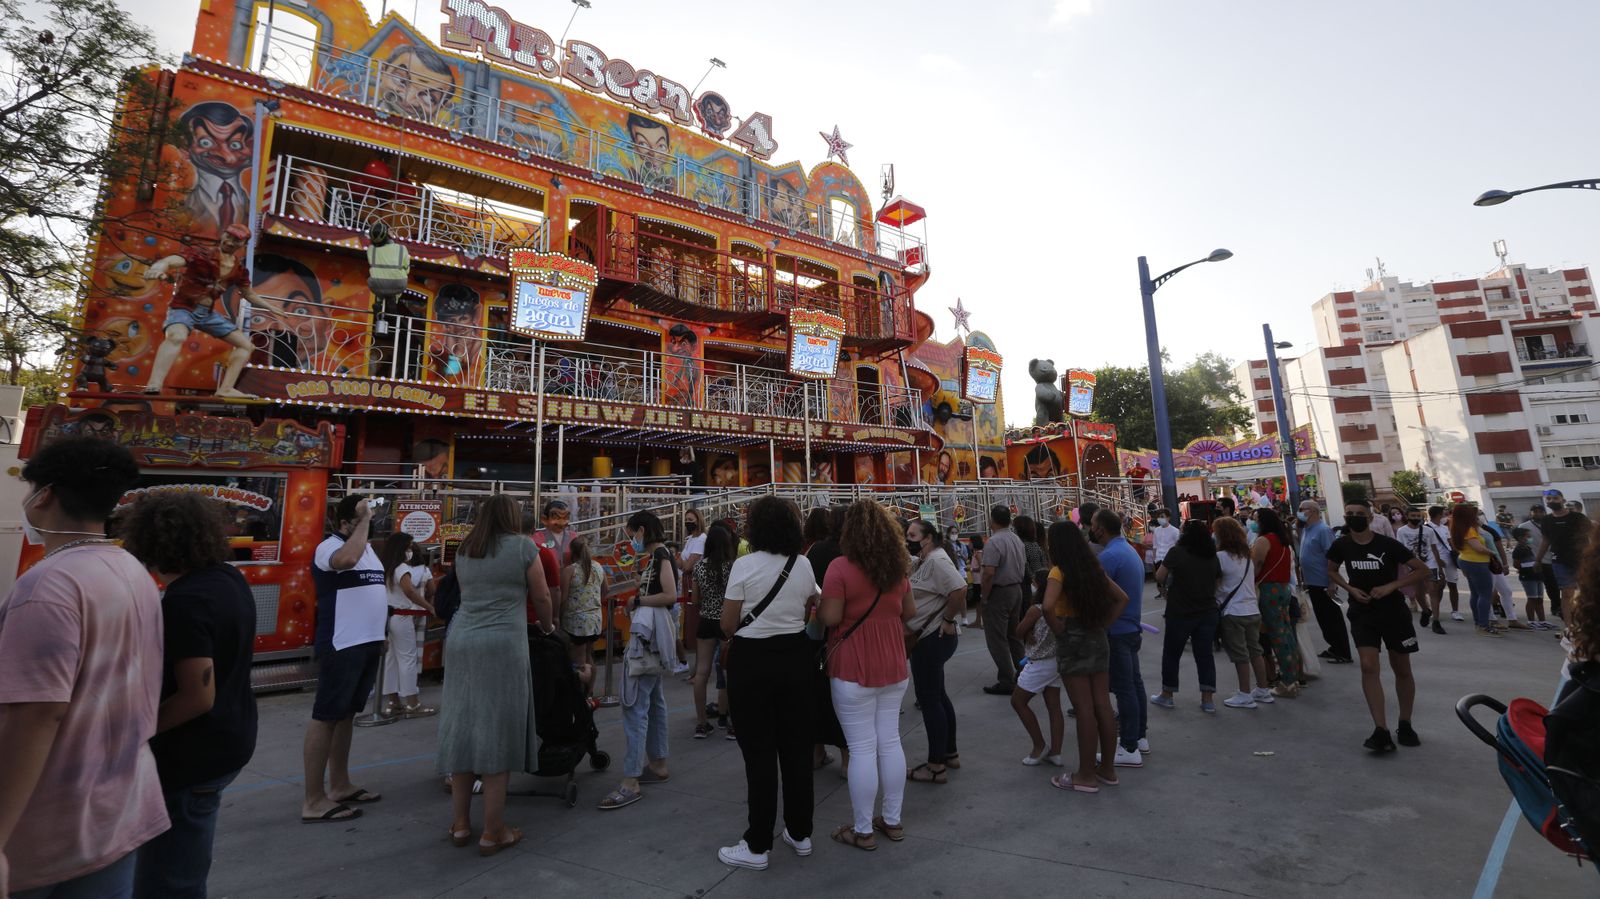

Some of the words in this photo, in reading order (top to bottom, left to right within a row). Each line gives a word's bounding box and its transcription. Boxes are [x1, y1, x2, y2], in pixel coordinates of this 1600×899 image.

[728, 111, 778, 160] 4
[521, 294, 560, 309] Juegos
[564, 301, 579, 311] de
[525, 309, 572, 329] agua
[799, 355, 828, 369] agua
[286, 380, 329, 398] PARA
[372, 382, 391, 398] LA
[463, 393, 506, 412] EL
[517, 398, 635, 422] SHOW
[644, 410, 683, 426] DE
[752, 418, 823, 437] BEAN
[828, 426, 845, 439] 4
[1215, 444, 1273, 463] JUEGOS
[399, 502, 441, 510] ATENCIÓN
[1350, 560, 1380, 570] PUMA
